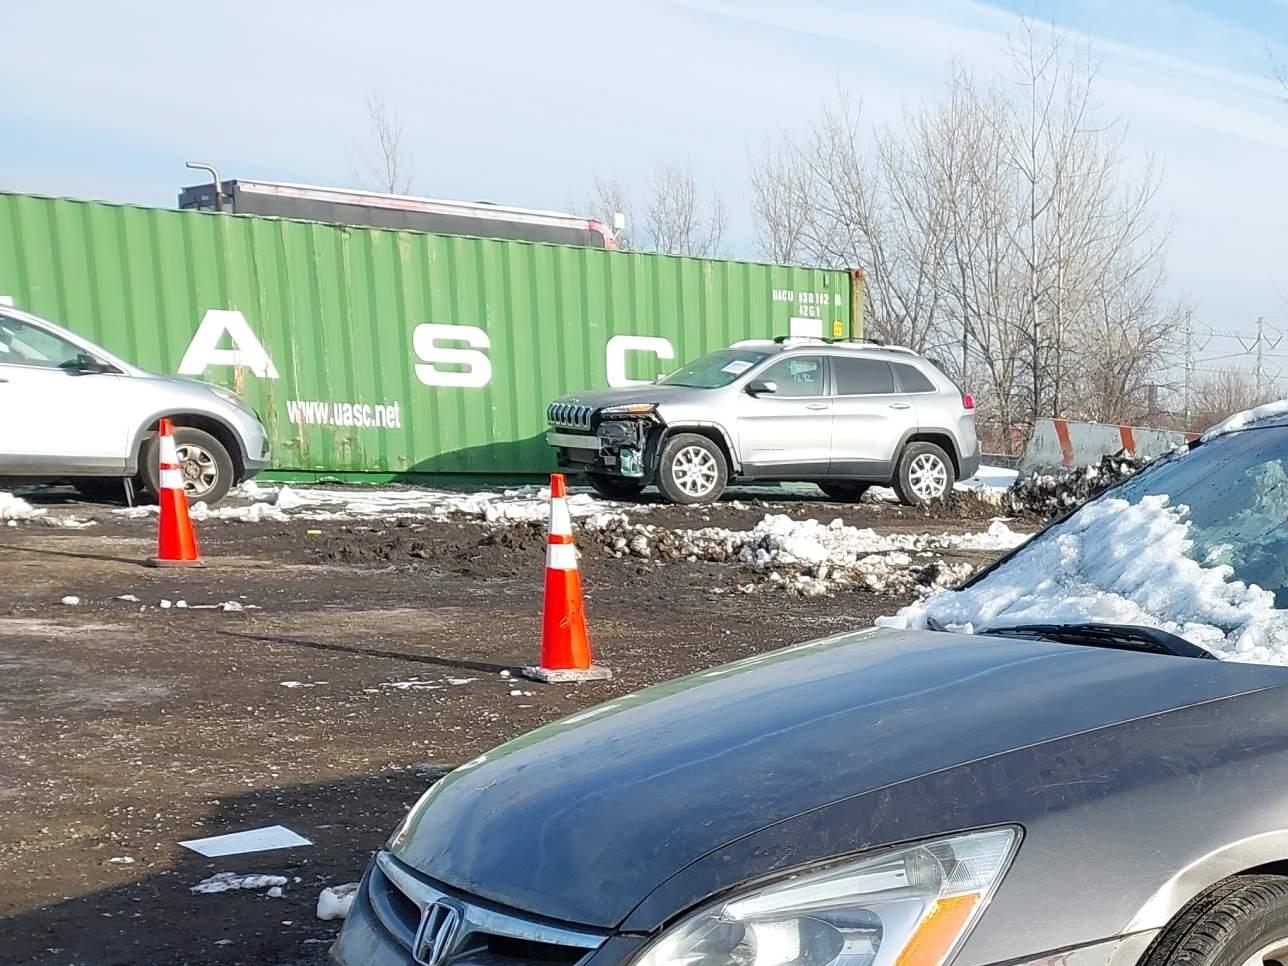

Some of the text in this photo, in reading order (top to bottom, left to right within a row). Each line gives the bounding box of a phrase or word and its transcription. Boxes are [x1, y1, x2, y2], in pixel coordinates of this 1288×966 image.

[177, 309, 674, 388] A S C
[286, 400, 401, 429] www.uasc.net
